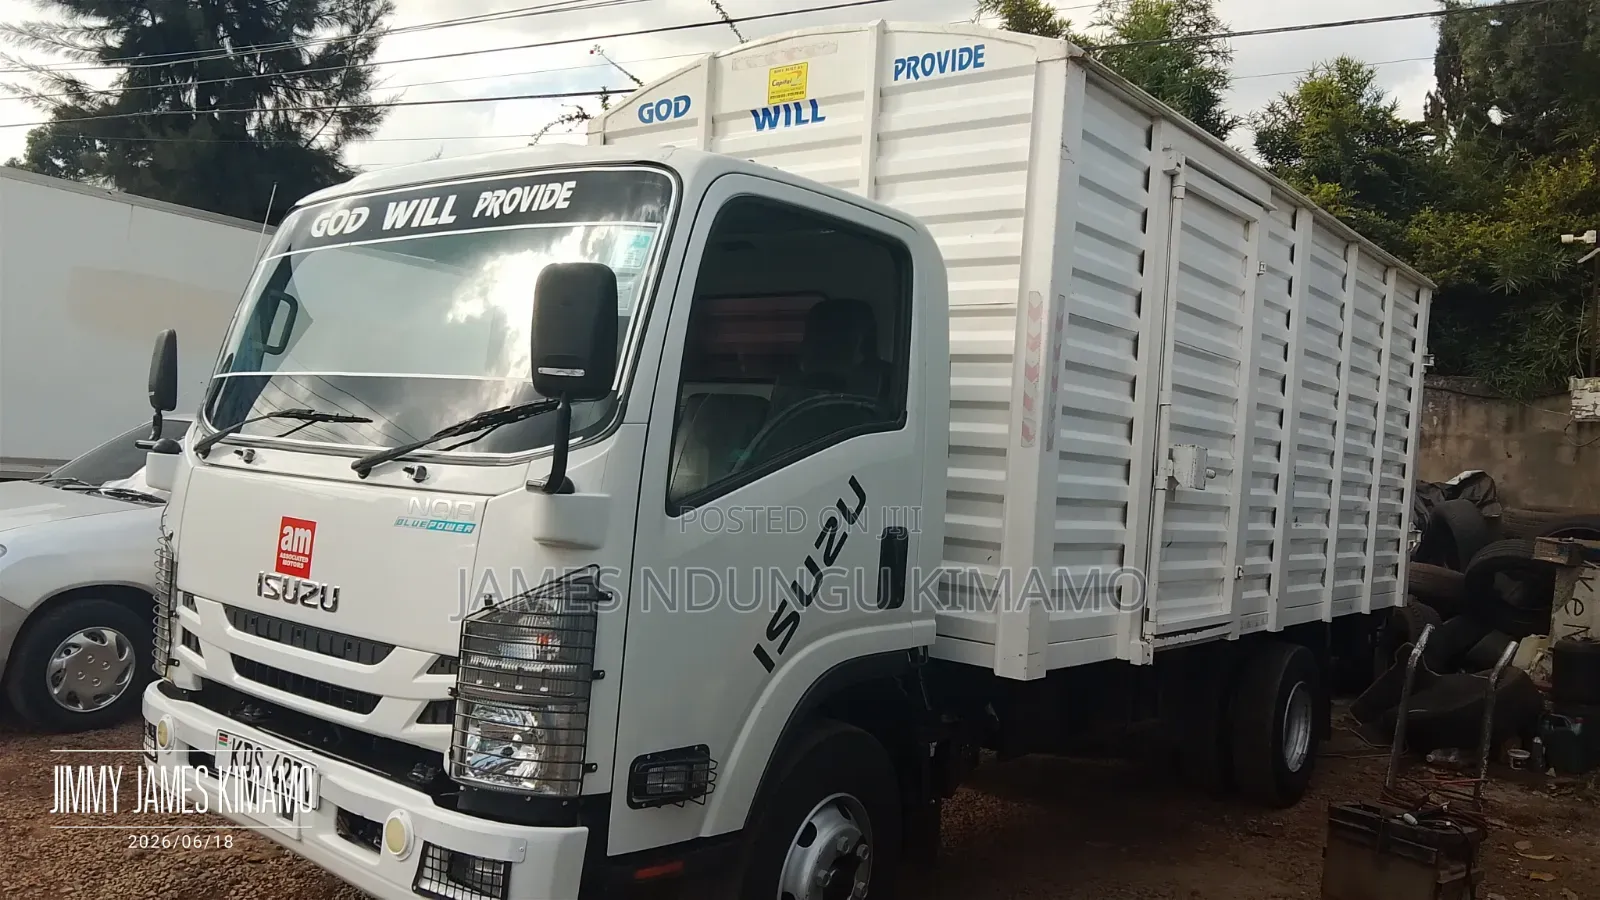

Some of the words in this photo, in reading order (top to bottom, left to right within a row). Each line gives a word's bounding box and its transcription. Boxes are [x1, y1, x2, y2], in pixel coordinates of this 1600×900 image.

[637, 95, 691, 124] GOD
[750, 98, 826, 132] WILL
[894, 44, 985, 82] PROVIDE
[311, 206, 370, 238] GOD
[381, 195, 457, 231] WILL
[472, 181, 576, 220] PROVIDE
[281, 525, 311, 555] am
[256, 571, 340, 613] ISUZU
[753, 475, 867, 673] ISUZU
